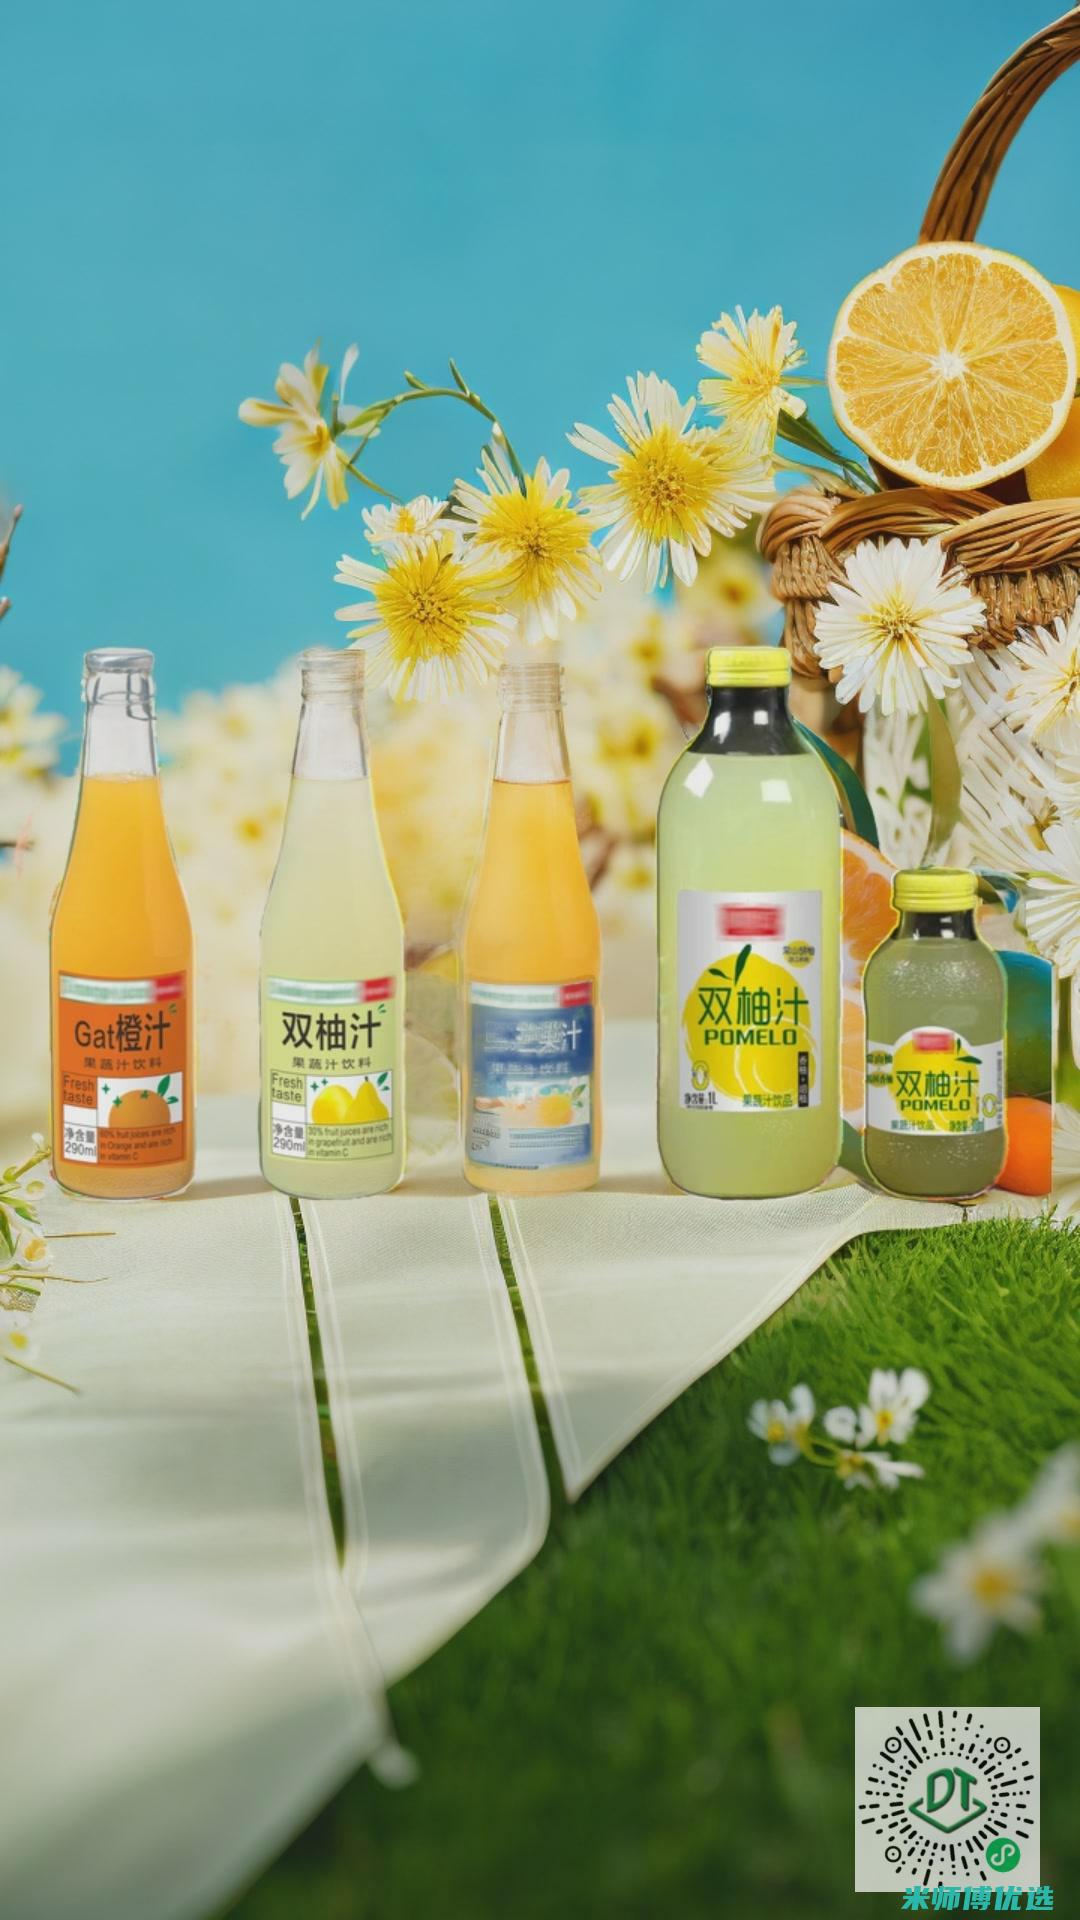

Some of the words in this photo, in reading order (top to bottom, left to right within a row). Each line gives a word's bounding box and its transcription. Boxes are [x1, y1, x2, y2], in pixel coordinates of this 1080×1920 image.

[698, 986, 809, 1026] 双柚汁
[281, 1010, 381, 1051] 双柚汁
[704, 1028, 798, 1046] POMELO
[83, 1056, 163, 1071] 果蔬汁饮料
[292, 1056, 372, 1071] 果蔬汁饮料
[63, 1074, 95, 1091] Fresh
[272, 1073, 304, 1089] Fresh
[896, 1070, 979, 1098] 双柚汁
[63, 1090, 94, 1105] taste
[271, 1087, 302, 1102] taste
[900, 1099, 971, 1111] POMELO
[64, 1127, 95, 1143] 净含量
[273, 1123, 304, 1140] 净含量
[64, 1141, 97, 1157] 290ml
[272, 1137, 306, 1153] 290ml
